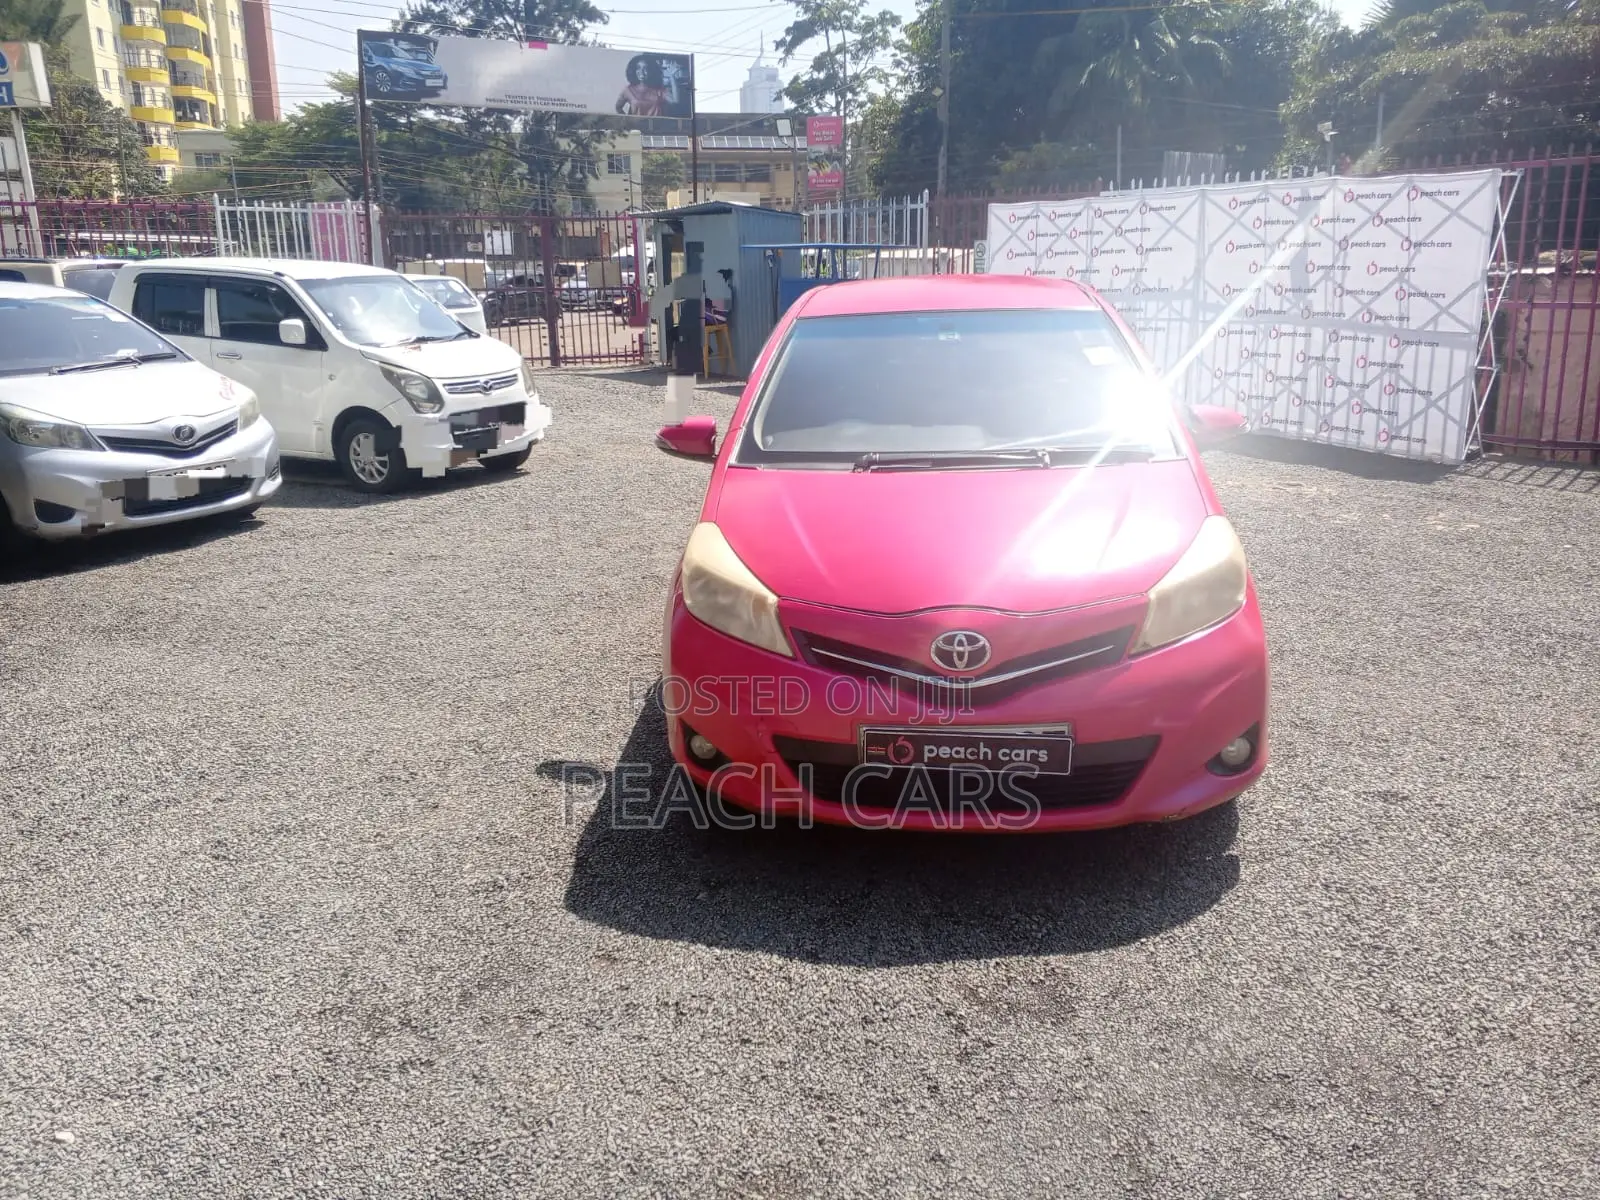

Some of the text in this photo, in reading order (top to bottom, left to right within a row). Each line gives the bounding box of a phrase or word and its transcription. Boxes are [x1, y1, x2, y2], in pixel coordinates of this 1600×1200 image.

[1356, 192, 1376, 200] peach
[1420, 188, 1442, 198] peach
[1321, 216, 1340, 224] peach
[1384, 216, 1406, 224] peach
[1351, 240, 1370, 249] peach
[1414, 240, 1436, 249] peach
[1317, 264, 1335, 272] peach
[1379, 265, 1400, 274] peach
[1346, 288, 1365, 296] peach
[1408, 290, 1428, 299] peach
[1312, 310, 1331, 318] peach
[1374, 314, 1394, 322] peach
[1340, 334, 1359, 342] peach
[1401, 338, 1422, 347] peach
[923, 742, 1048, 762] peach cars
